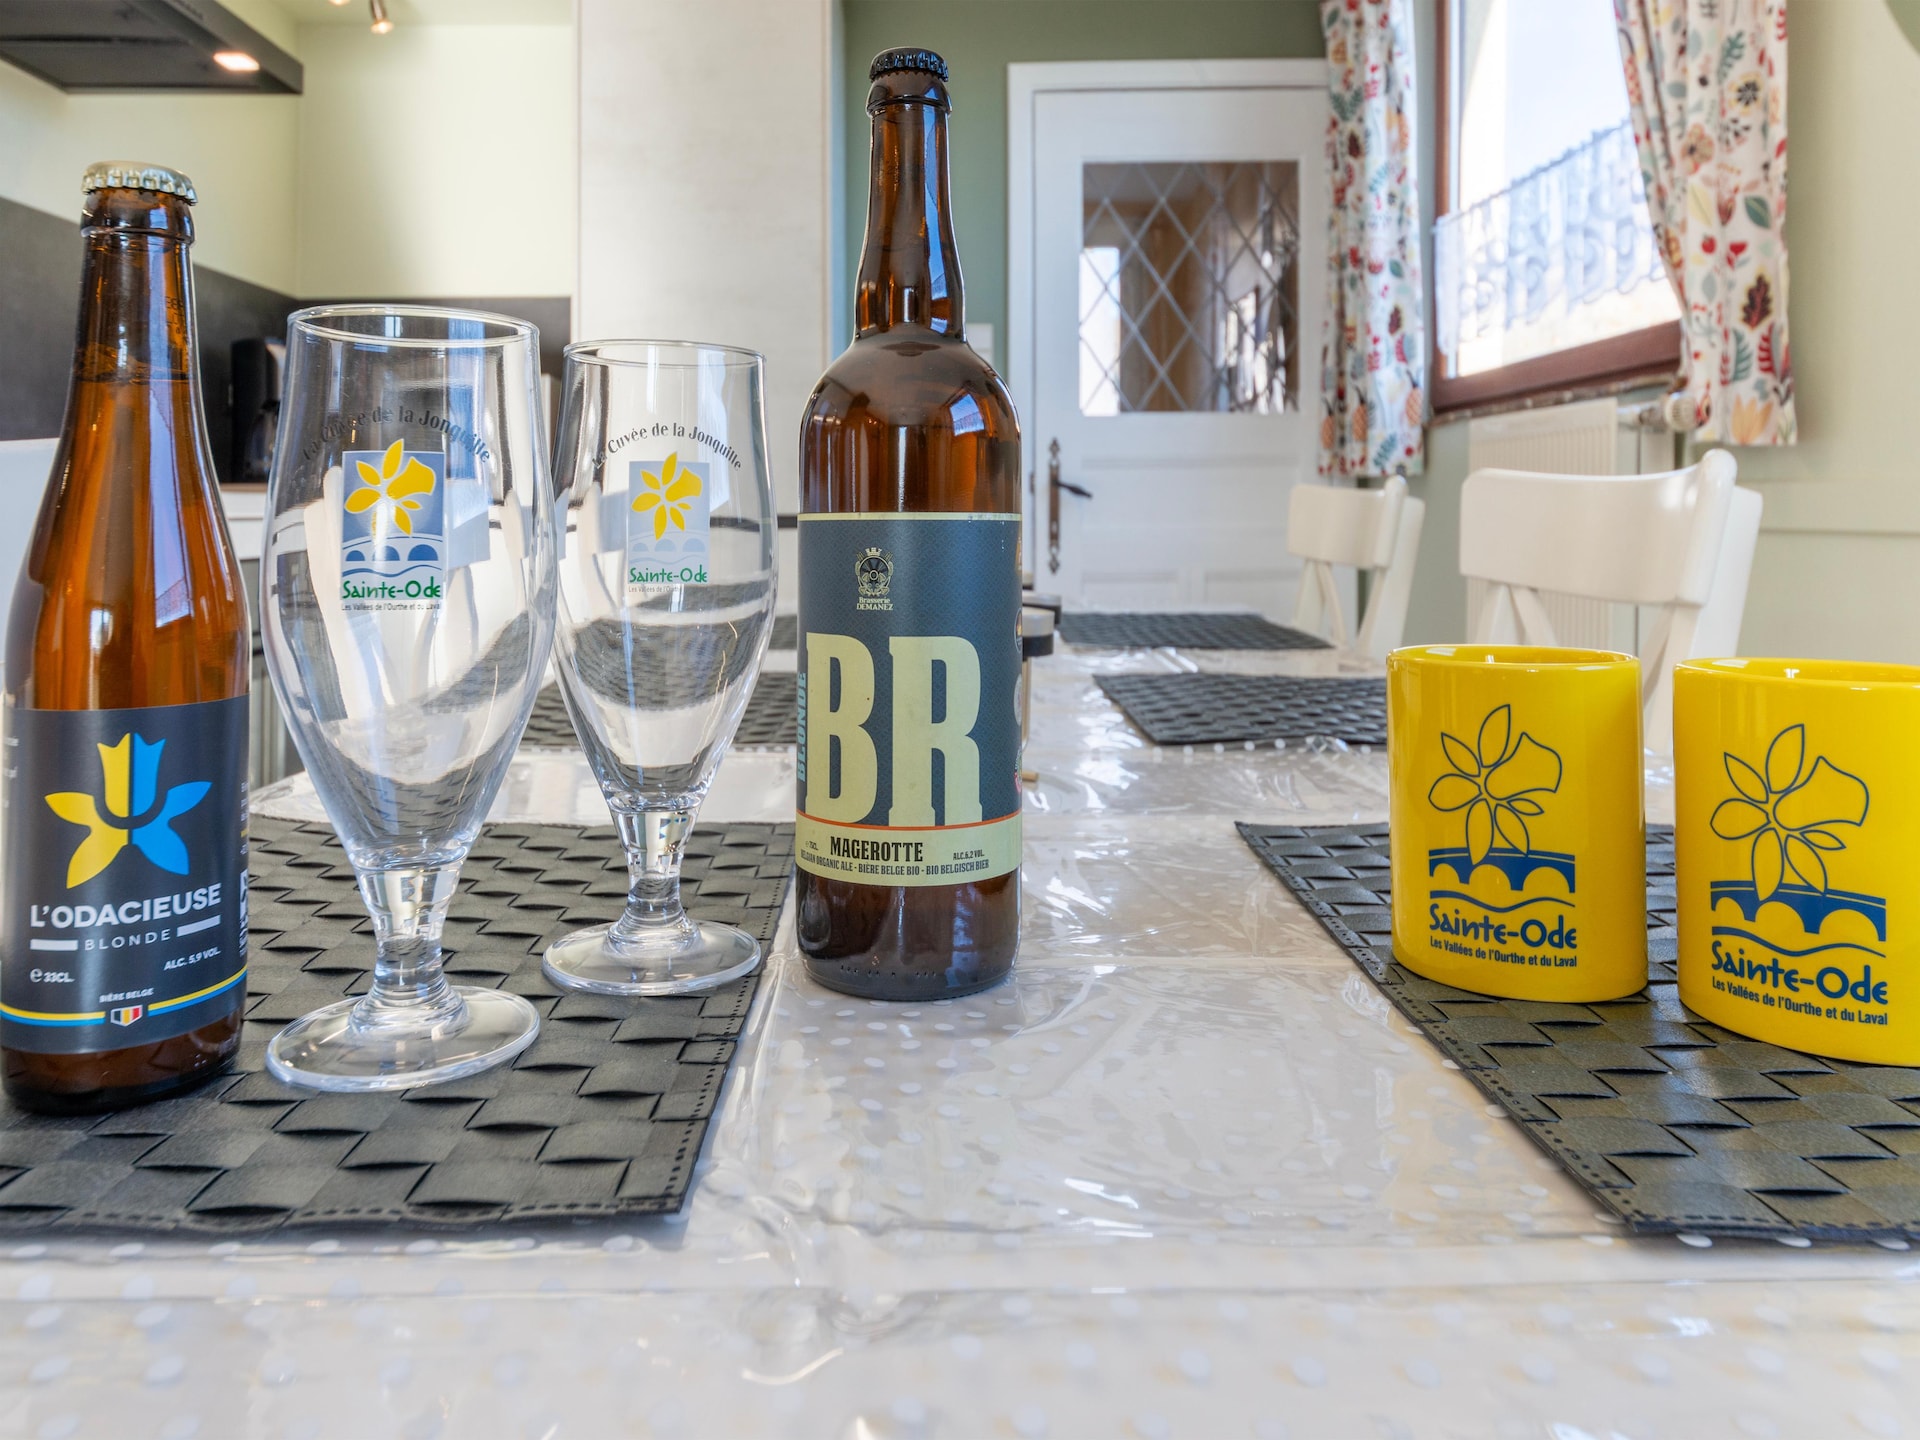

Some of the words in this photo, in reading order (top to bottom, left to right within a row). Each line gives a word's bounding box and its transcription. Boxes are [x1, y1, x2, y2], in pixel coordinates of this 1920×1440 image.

[399, 406, 413, 423] la
[418, 410, 490, 463] Jonquille
[607, 427, 648, 454] Cuvée
[652, 422, 669, 437] de
[673, 422, 685, 437] la
[688, 426, 741, 471] Jonquille
[342, 576, 441, 599] Sainte-Ode
[629, 564, 708, 583] Sainte-Ode
[856, 603, 894, 611] DEMANEZ
[797, 672, 806, 782] BLONDE
[805, 632, 983, 827] BR
[830, 836, 923, 862] MAGEROTTE
[816, 855, 839, 870] ORGANIC
[840, 861, 853, 872] ALE
[858, 861, 879, 875] BIÈRE
[881, 865, 905, 876] BELGE
[906, 866, 920, 875] BIO
[926, 865, 939, 875] BIO
[940, 861, 974, 875] BELGISCH
[975, 859, 989, 870] BIER
[30, 883, 222, 928] L'ODACIEUSE
[84, 928, 172, 951] BLONDE
[1429, 903, 1577, 949] Sainte-Ode
[163, 958, 187, 971] ALC.
[1430, 936, 1442, 949] Les
[1444, 939, 1473, 957] Vallées
[1475, 947, 1486, 959] de
[1489, 949, 1525, 965] l'Ourthe
[1528, 955, 1538, 966] et
[1540, 956, 1552, 966] du
[1554, 956, 1577, 967] Laval
[1711, 940, 1888, 1005] Sainte-Ode
[125, 987, 154, 1000] BELGE
[1712, 975, 1725, 992] Les
[1727, 982, 1760, 1003] Vallées
[1762, 992, 1775, 1007] de
[1778, 996, 1822, 1017] l'Ourthe
[1825, 1007, 1837, 1020] et
[1841, 1008, 1855, 1022] du
[1858, 1010, 1888, 1025] Laval
